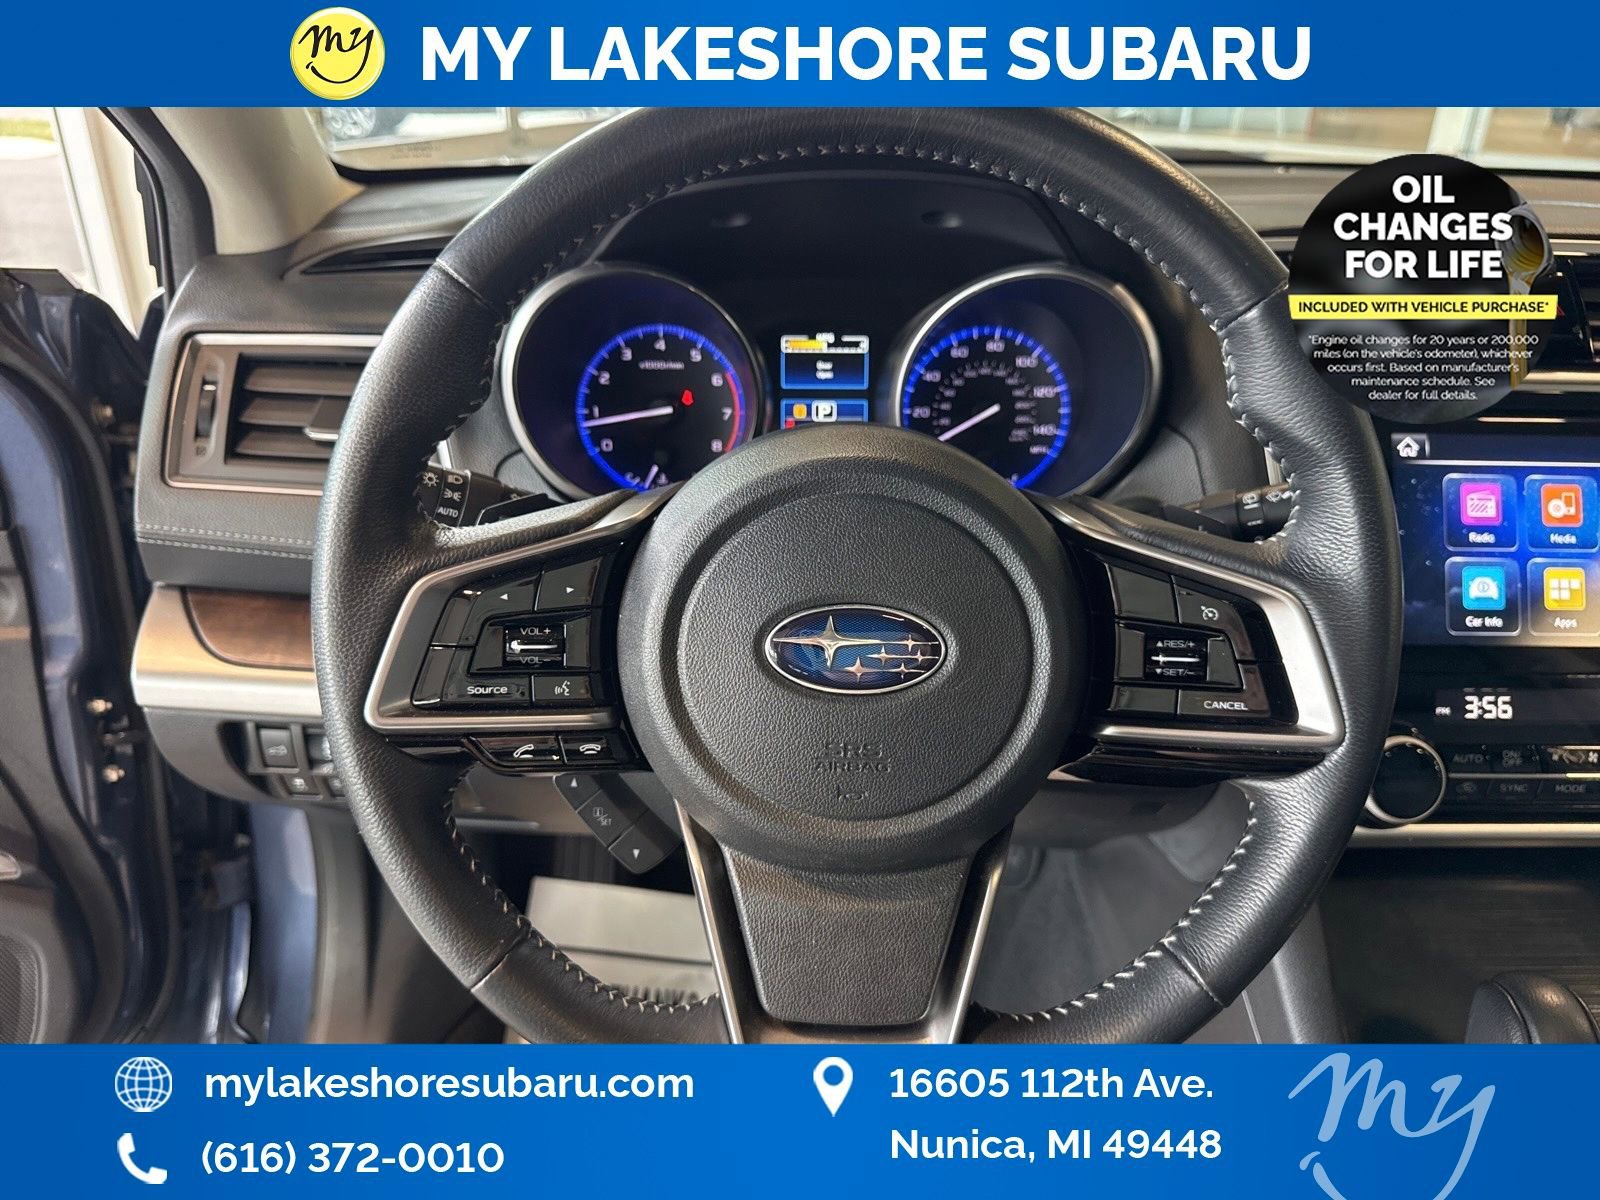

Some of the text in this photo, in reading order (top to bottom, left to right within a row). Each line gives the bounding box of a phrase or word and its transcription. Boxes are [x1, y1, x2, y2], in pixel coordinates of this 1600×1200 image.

[599, 370, 611, 386] 2
[722, 407, 733, 421] 7
[437, 505, 459, 519] AUTO
[1468, 531, 1496, 544] Radio
[1549, 533, 1577, 545] Media
[1465, 615, 1504, 628] Car Info
[1553, 616, 1578, 630] Apps
[466, 684, 509, 695] Source
[1203, 700, 1249, 711] CANCEL
[1463, 695, 1514, 720] 3:56
[1452, 753, 1484, 764] AUTO
[814, 760, 892, 773] AIRBAG
[1554, 783, 1587, 794] MODE
